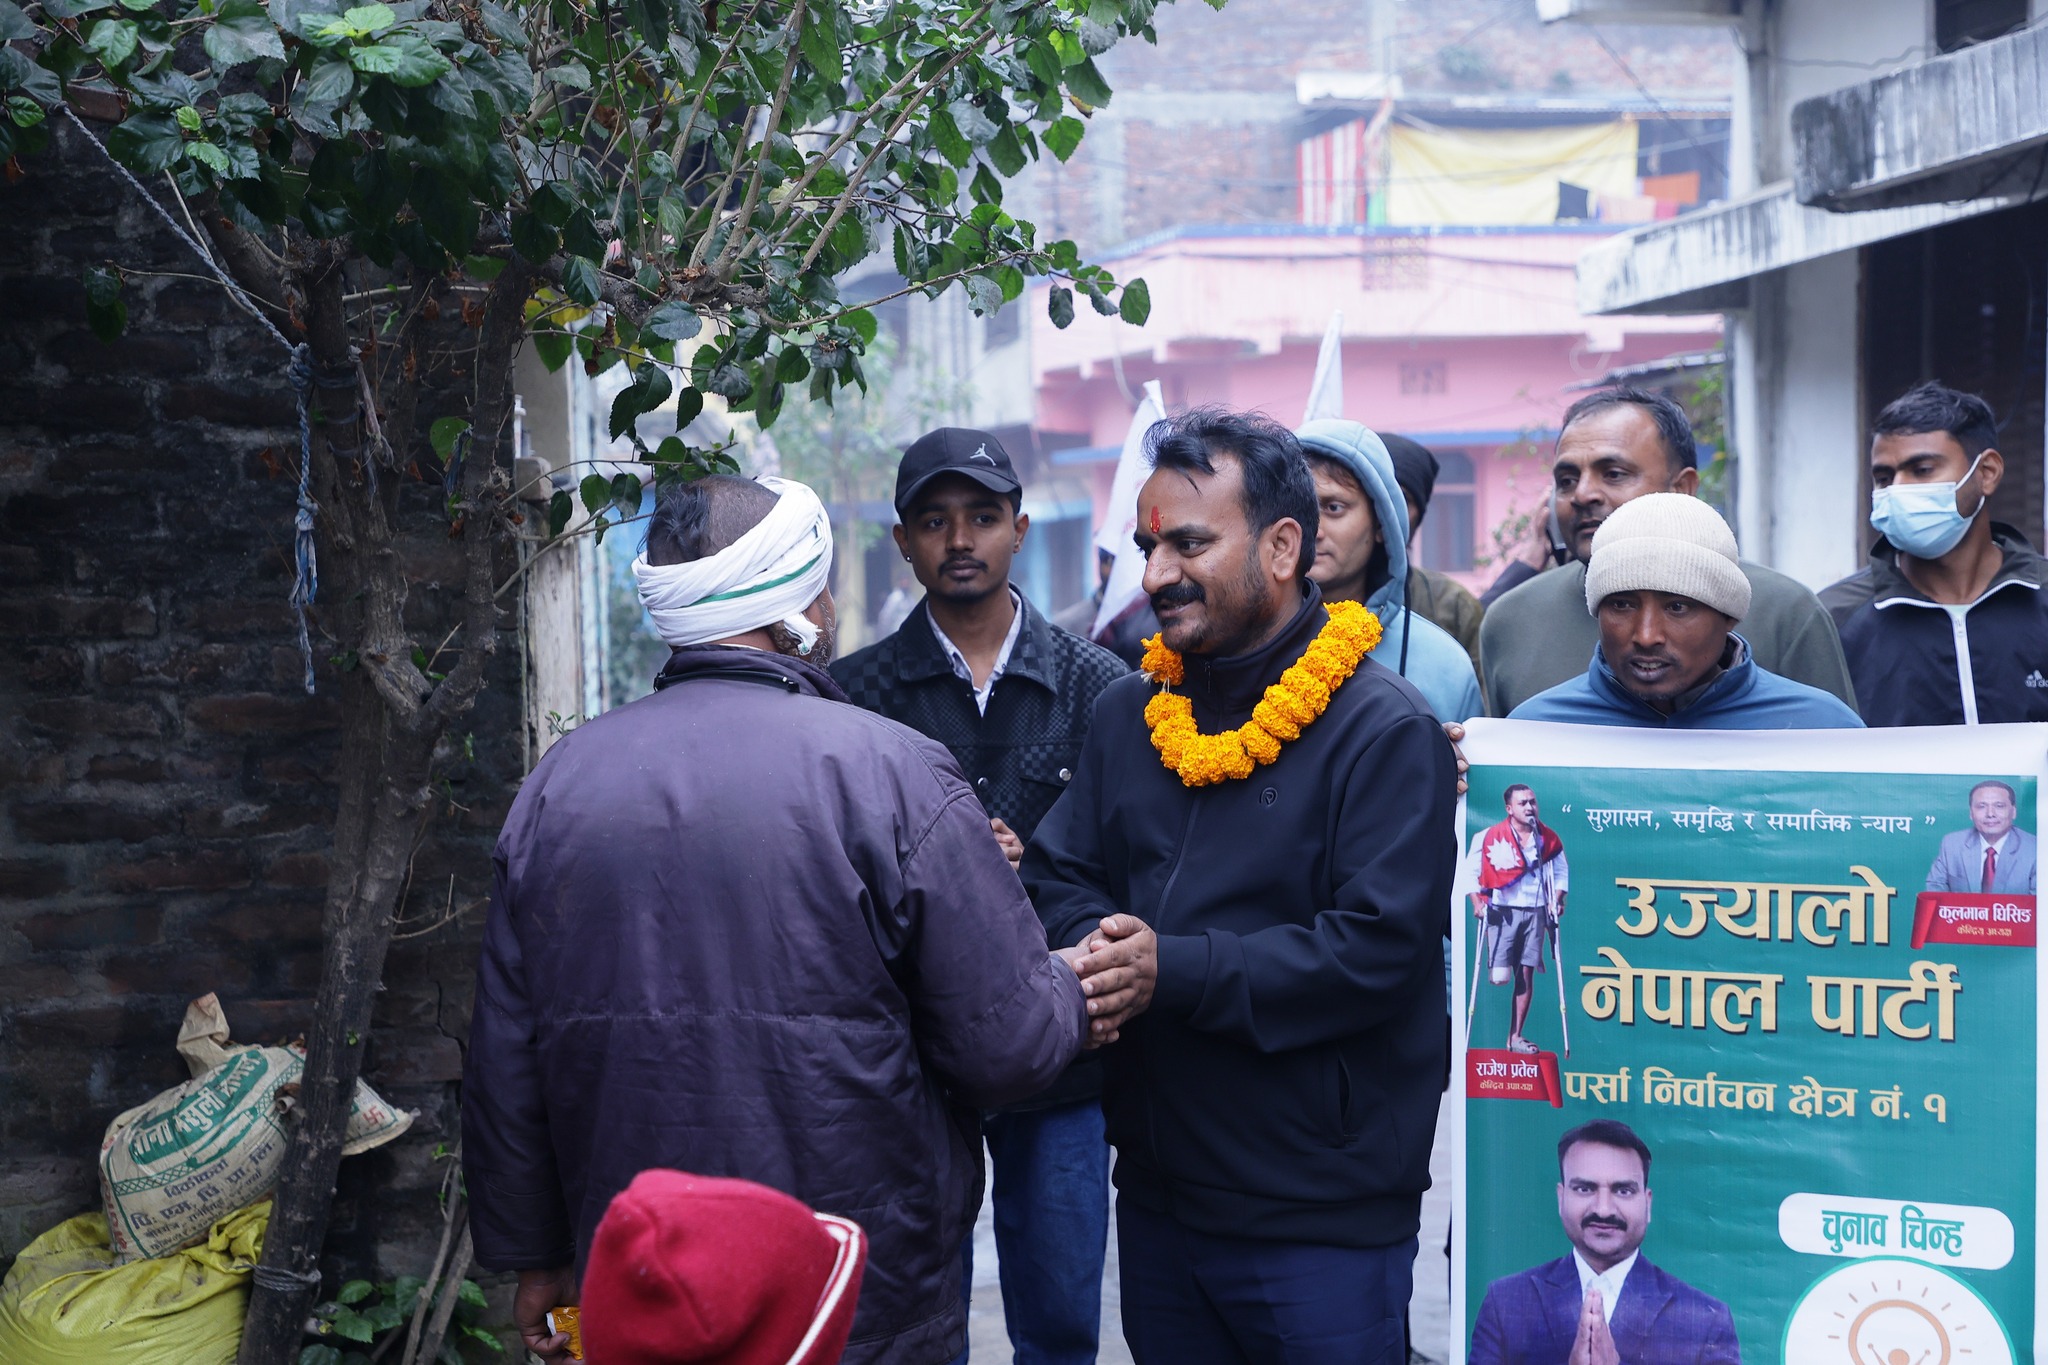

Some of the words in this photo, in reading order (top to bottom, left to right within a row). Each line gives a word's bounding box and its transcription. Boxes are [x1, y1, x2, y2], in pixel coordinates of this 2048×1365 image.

[1585, 808, 1660, 833] सुशासन,
[1670, 805, 1736, 833] समृद्धि
[1742, 812, 1755, 830] र
[1764, 808, 1853, 832] समाजिक
[1860, 815, 1913, 833] न्याय
[1614, 865, 1898, 947] उज्यालो
[1938, 904, 1989, 924] कुलमान
[1578, 946, 1785, 1034] नेपाल
[1805, 960, 1963, 1042] पार्टी
[1475, 1058, 1508, 1077] राजेश
[1563, 1066, 1633, 1105] पर्सा
[1642, 1066, 1778, 1112] निर्वाचन
[1788, 1075, 1859, 1119] क्षेत्र
[1869, 1084, 1911, 1121] नं.
[1922, 1093, 1947, 1124] १
[1821, 1209, 1889, 1253] चुनाव
[1899, 1204, 1966, 1257] चिन्ह
